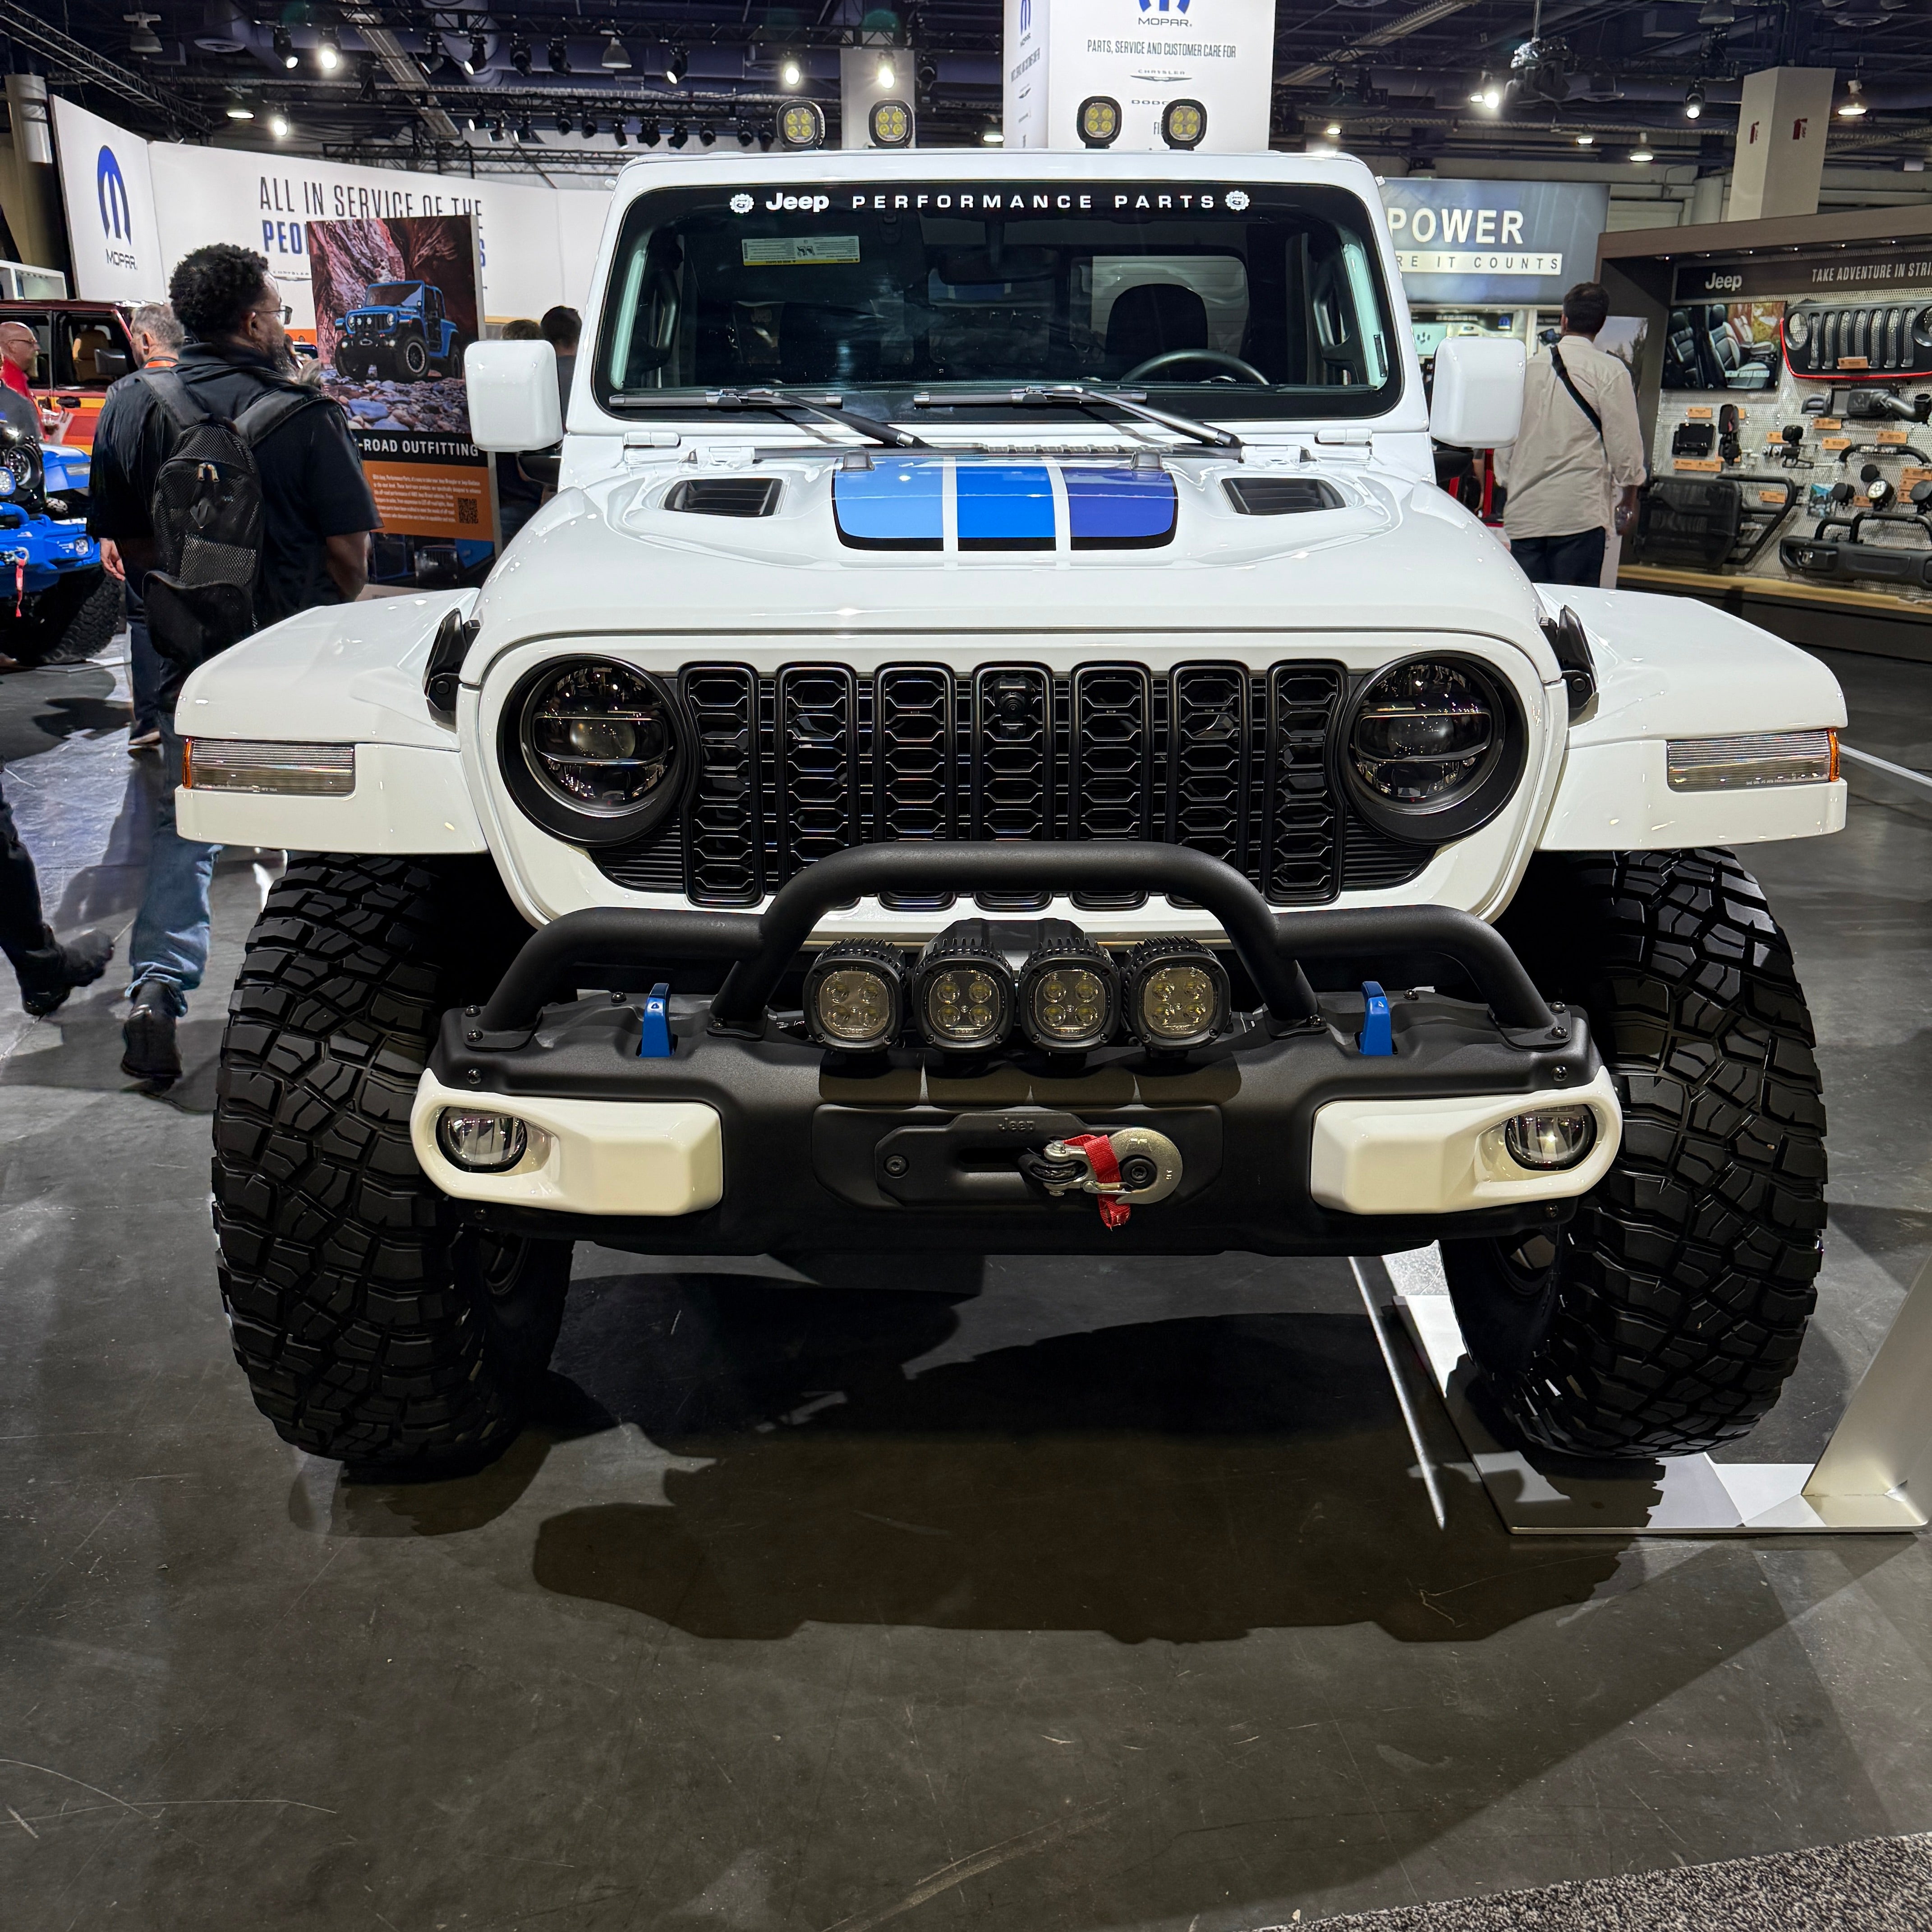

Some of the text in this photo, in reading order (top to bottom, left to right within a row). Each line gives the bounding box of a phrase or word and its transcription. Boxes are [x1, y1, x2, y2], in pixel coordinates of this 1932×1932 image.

[1087, 39, 1236, 58] PARTS, SERVICE AND CUSTOMER CARE FOR
[260, 176, 482, 218] ALL IN SERVICE OF THE
[766, 192, 1214, 212] Jeep PERFORMANCE PARTS
[1388, 207, 1523, 244] POWER
[262, 220, 309, 255] PEO
[1437, 256, 1456, 268] IT
[1474, 257, 1558, 270] COUNTS
[1812, 262, 1932, 282] TAKE ADVENTURE IN STRI
[1705, 272, 1742, 291] Jeep
[402, 440, 478, 457] OUTFITTING
